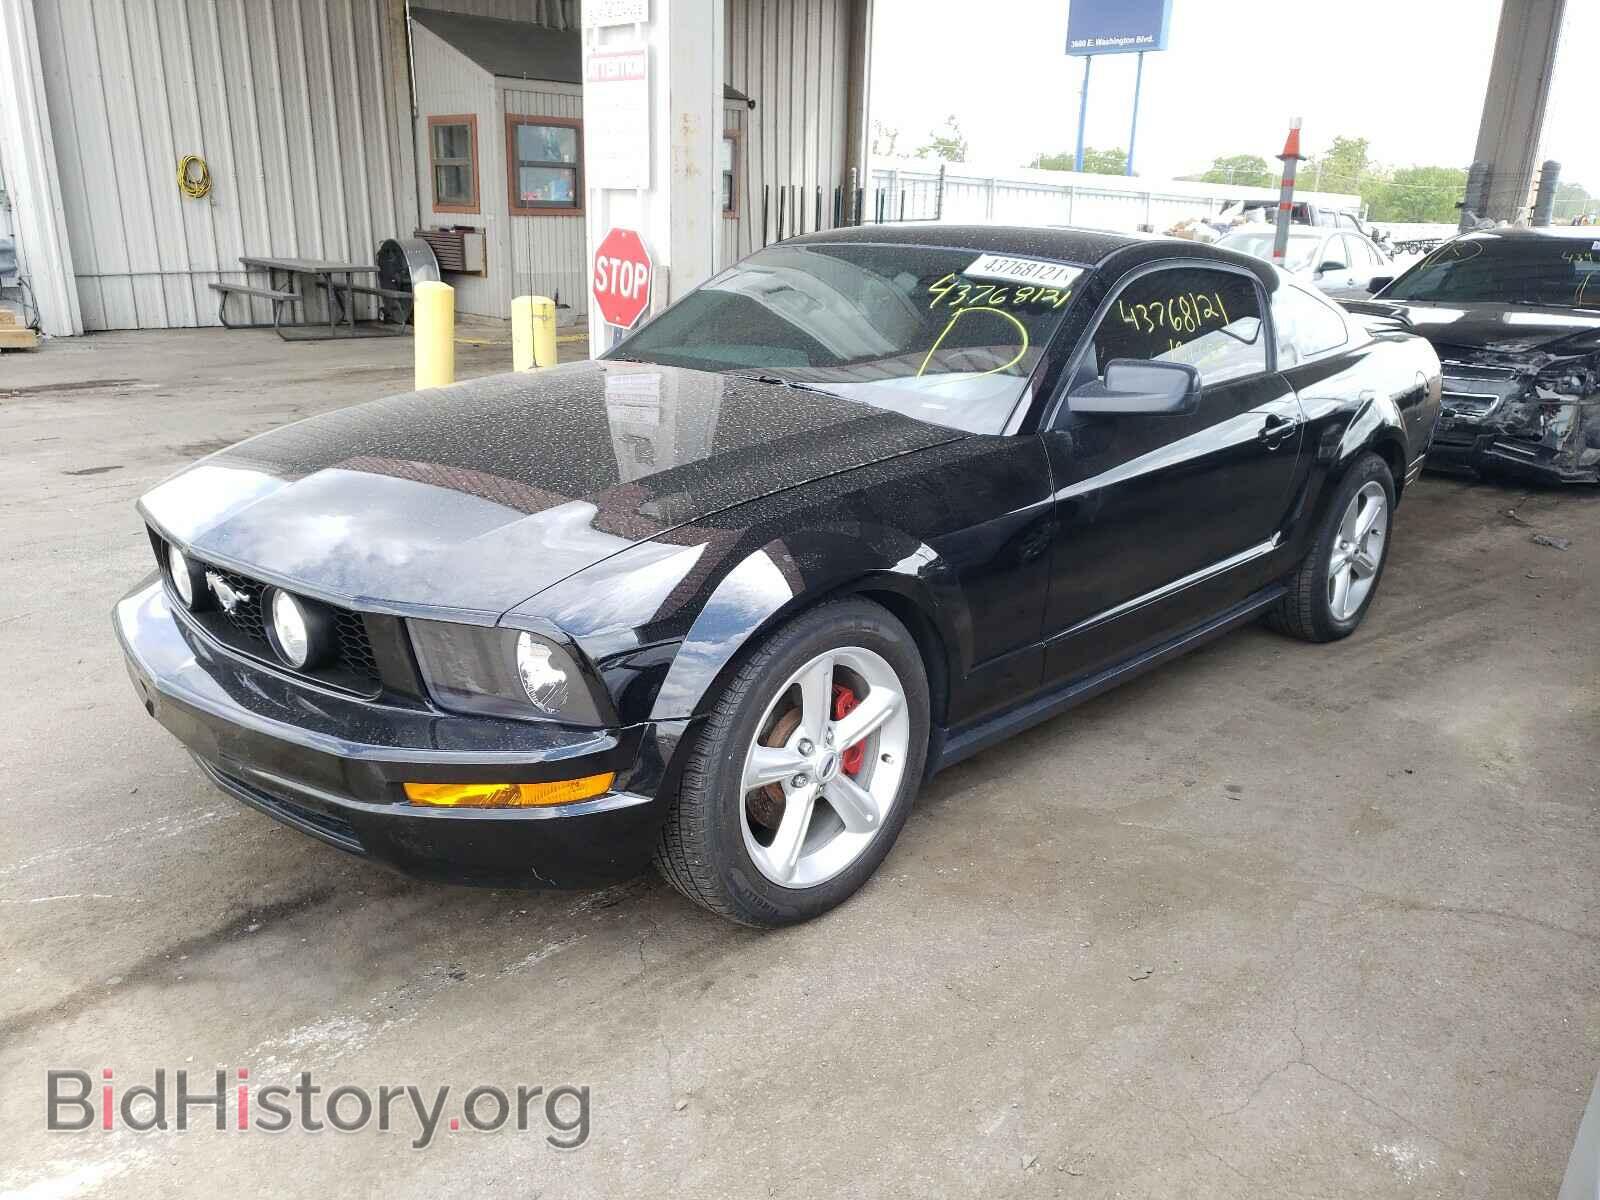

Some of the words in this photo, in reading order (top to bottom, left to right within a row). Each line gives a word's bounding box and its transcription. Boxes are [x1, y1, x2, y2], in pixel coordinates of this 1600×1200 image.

[1096, 37, 1135, 46] Washington
[1136, 35, 1154, 44] Blvd.
[595, 255, 648, 299] STOP
[984, 257, 1064, 281] 43768121
[928, 272, 1072, 309] 43768121
[1118, 292, 1231, 333] 43768121
